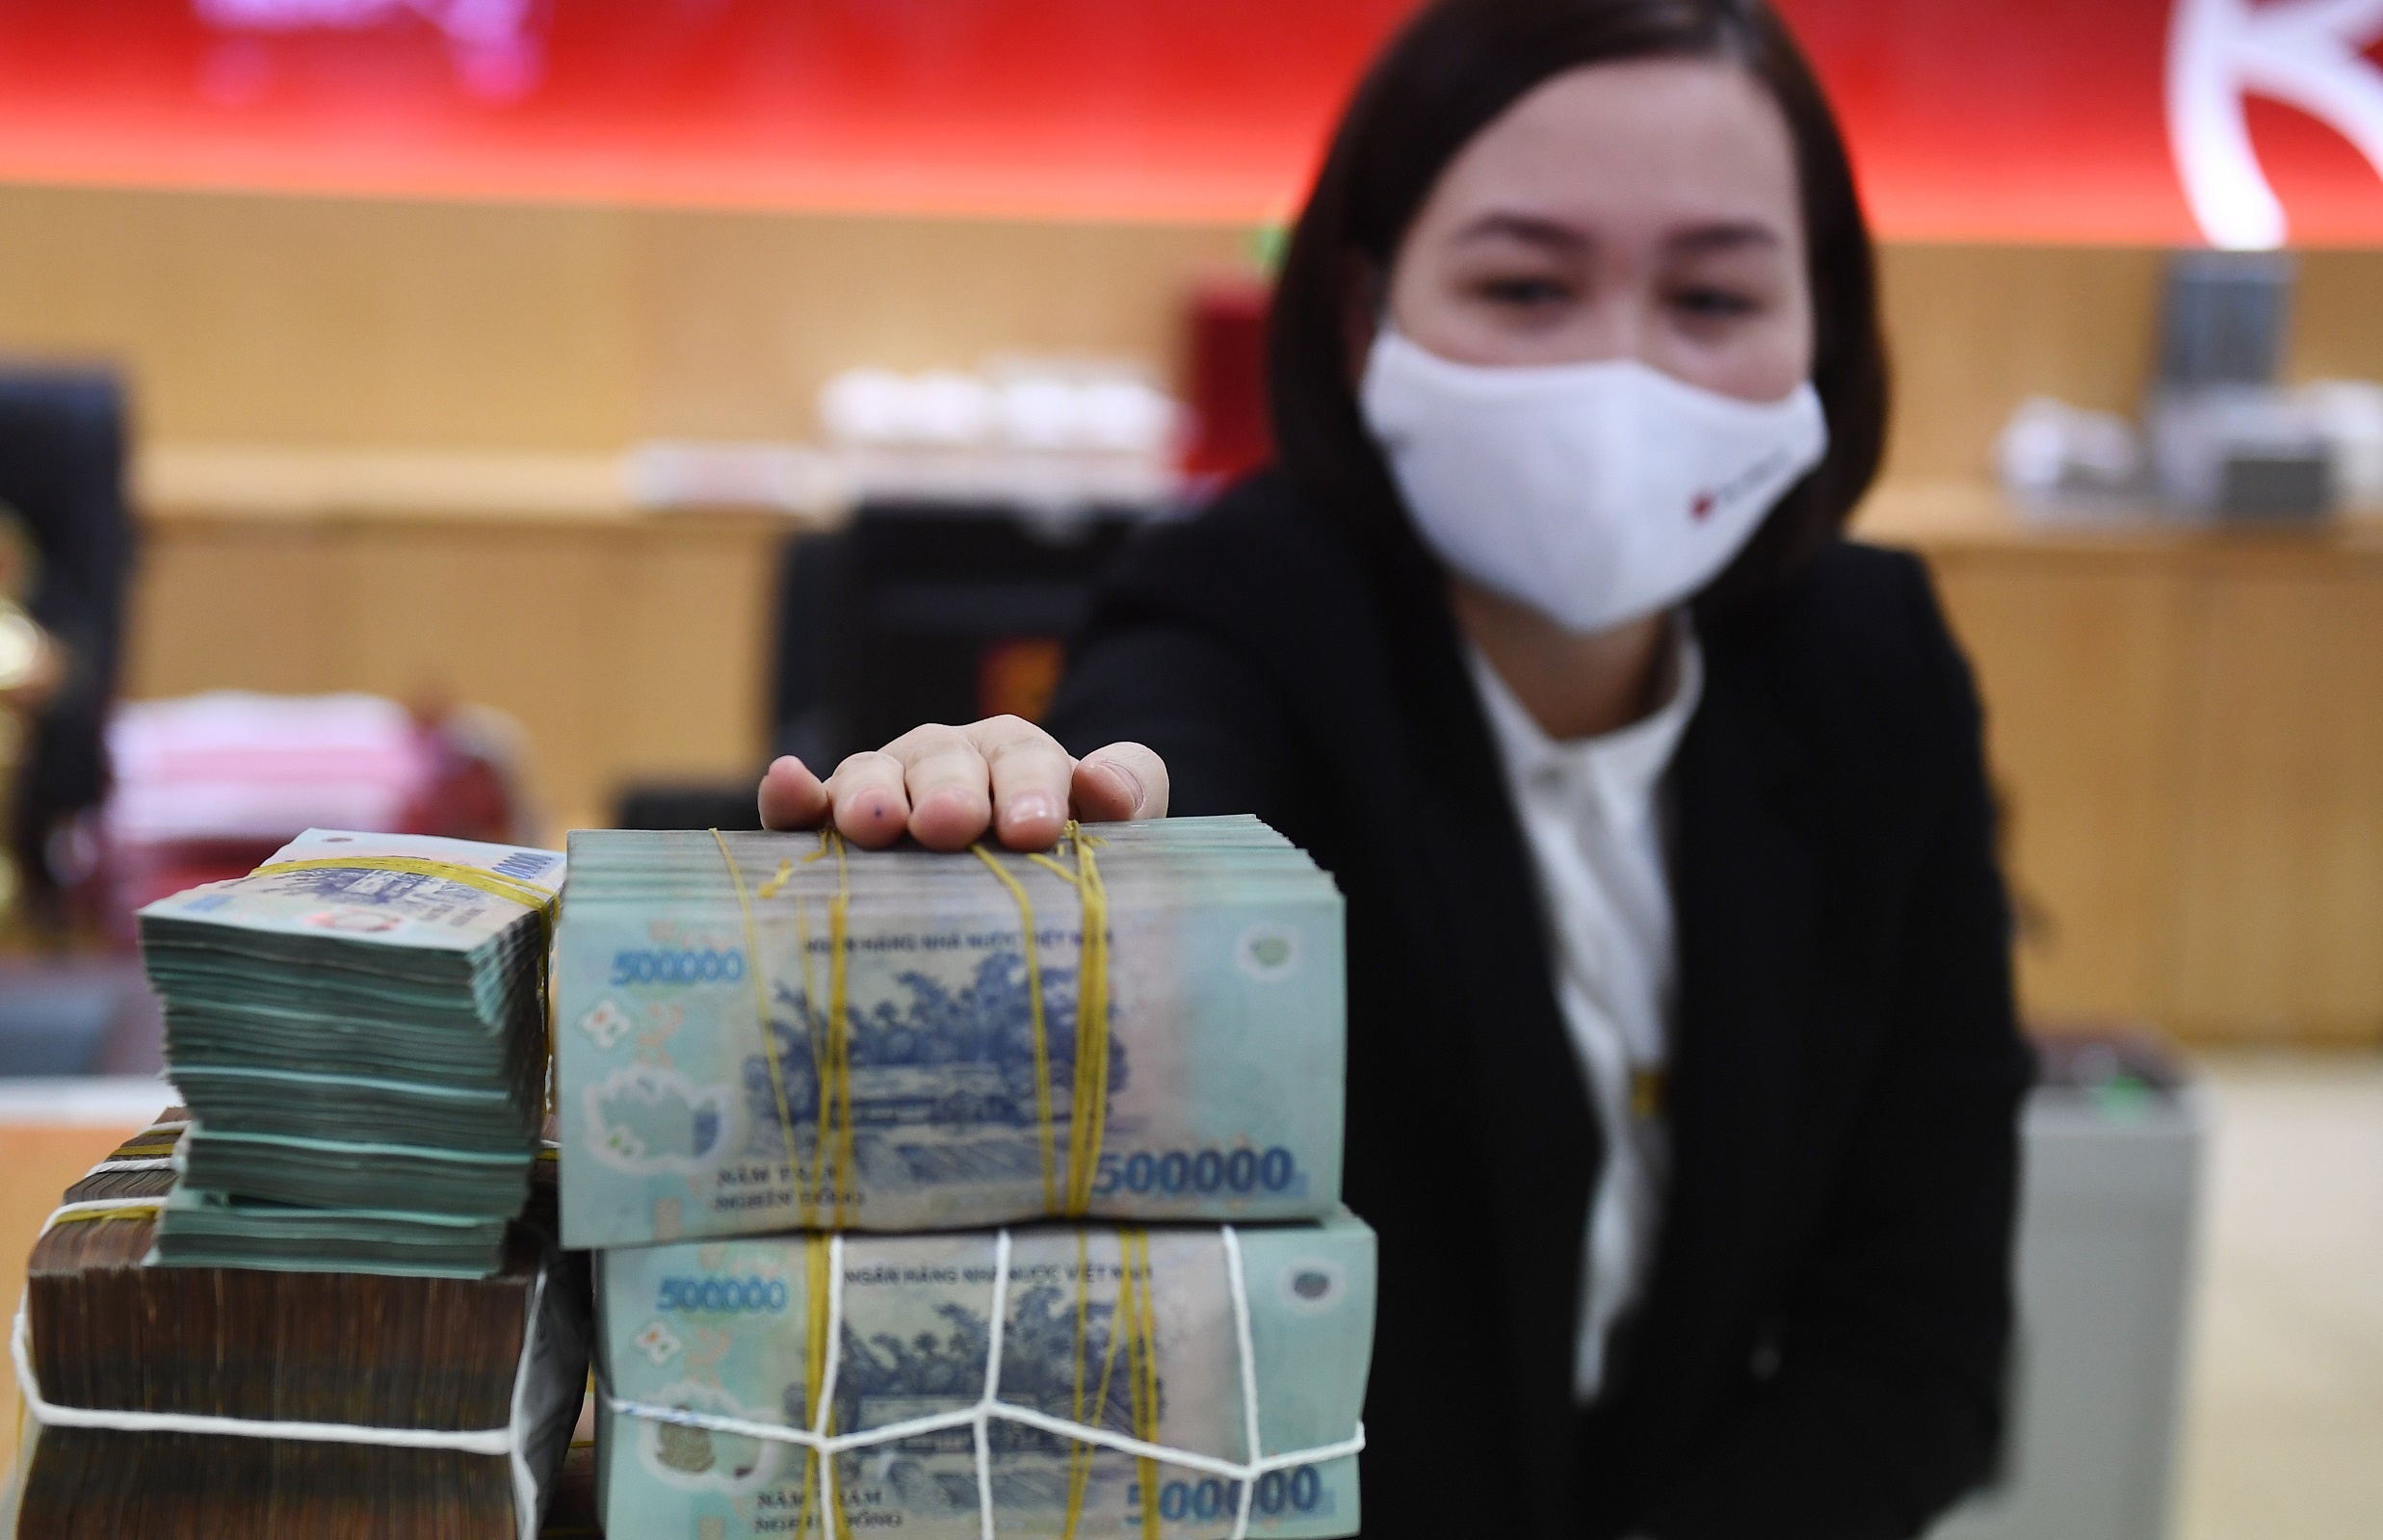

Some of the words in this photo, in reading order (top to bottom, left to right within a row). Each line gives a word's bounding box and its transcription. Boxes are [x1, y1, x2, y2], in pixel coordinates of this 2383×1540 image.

[610, 950, 743, 986] 500000
[1093, 1145, 1294, 1195] 500000
[656, 1277, 787, 1316] 500000
